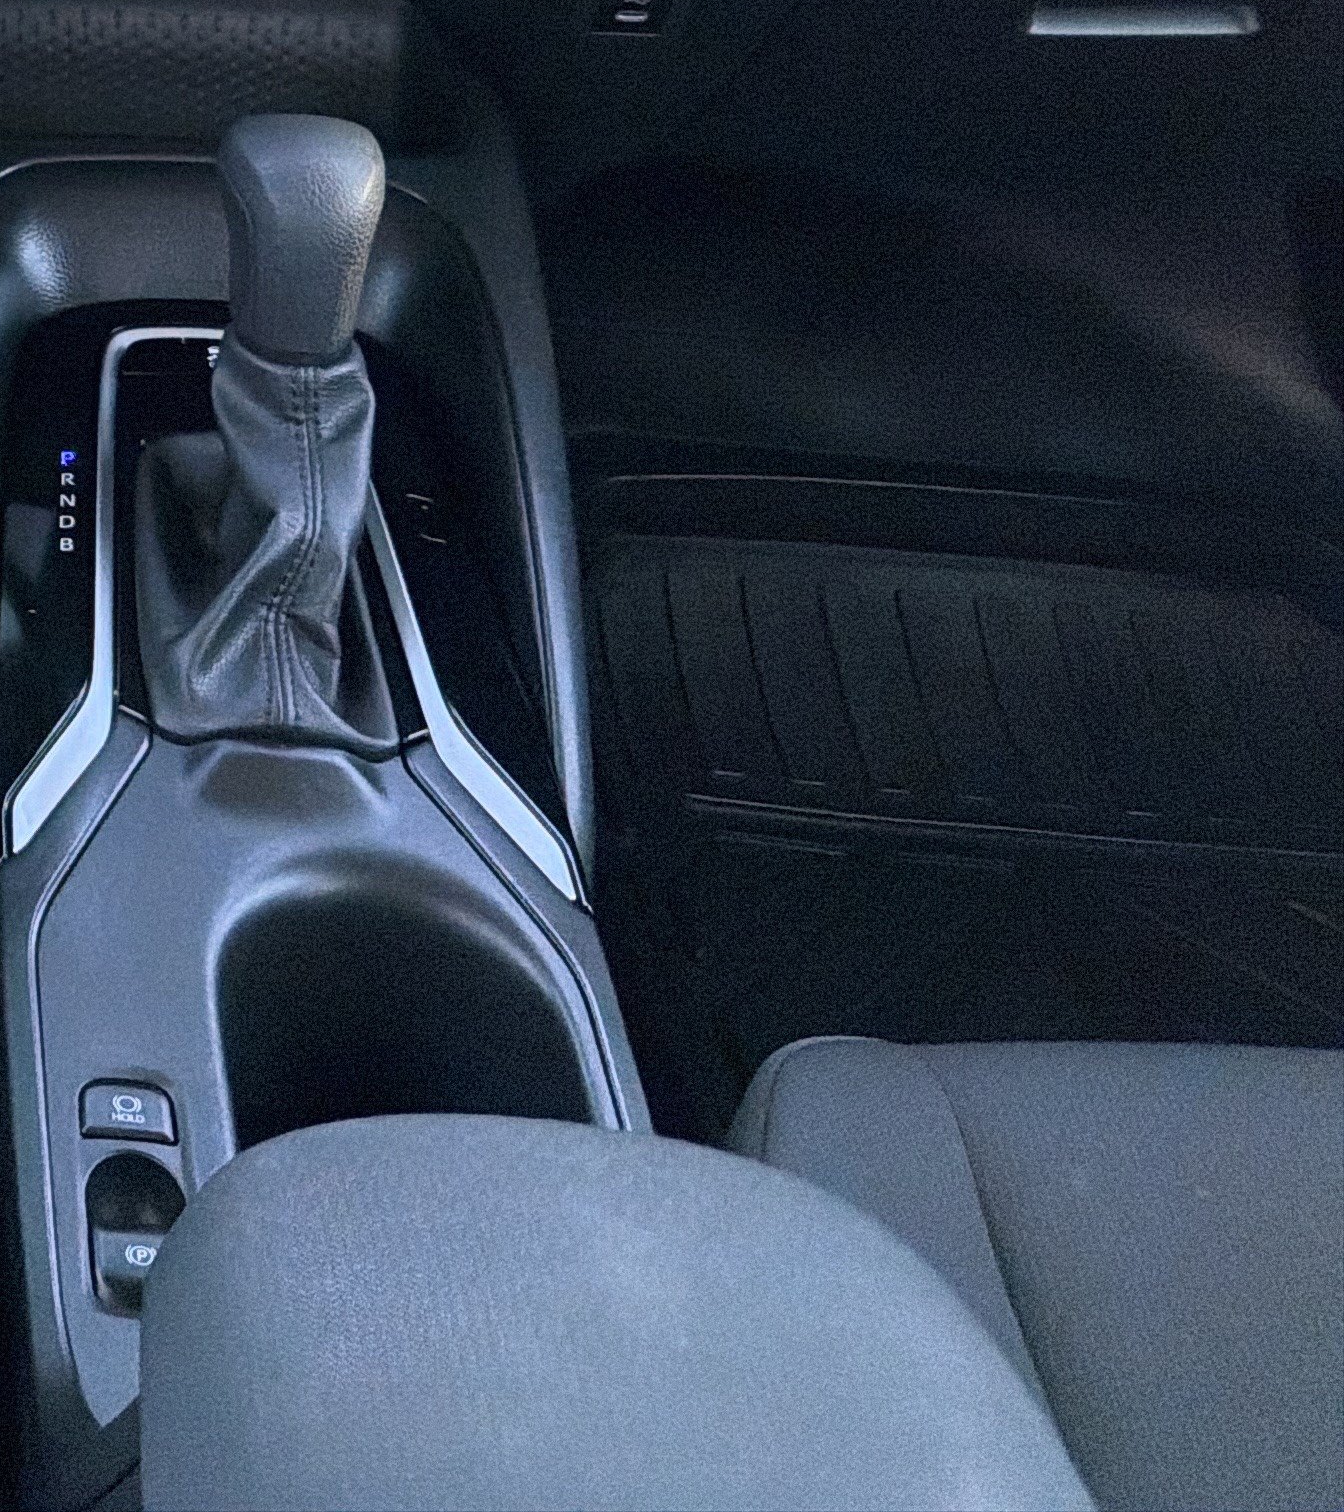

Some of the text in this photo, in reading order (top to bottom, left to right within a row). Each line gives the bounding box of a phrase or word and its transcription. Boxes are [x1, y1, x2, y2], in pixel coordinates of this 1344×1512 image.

[59, 450, 75, 467] P
[59, 472, 75, 486] R
[59, 493, 76, 508] N
[59, 515, 76, 529] D
[59, 537, 74, 552] B
[111, 1112, 146, 1124] HOLD
